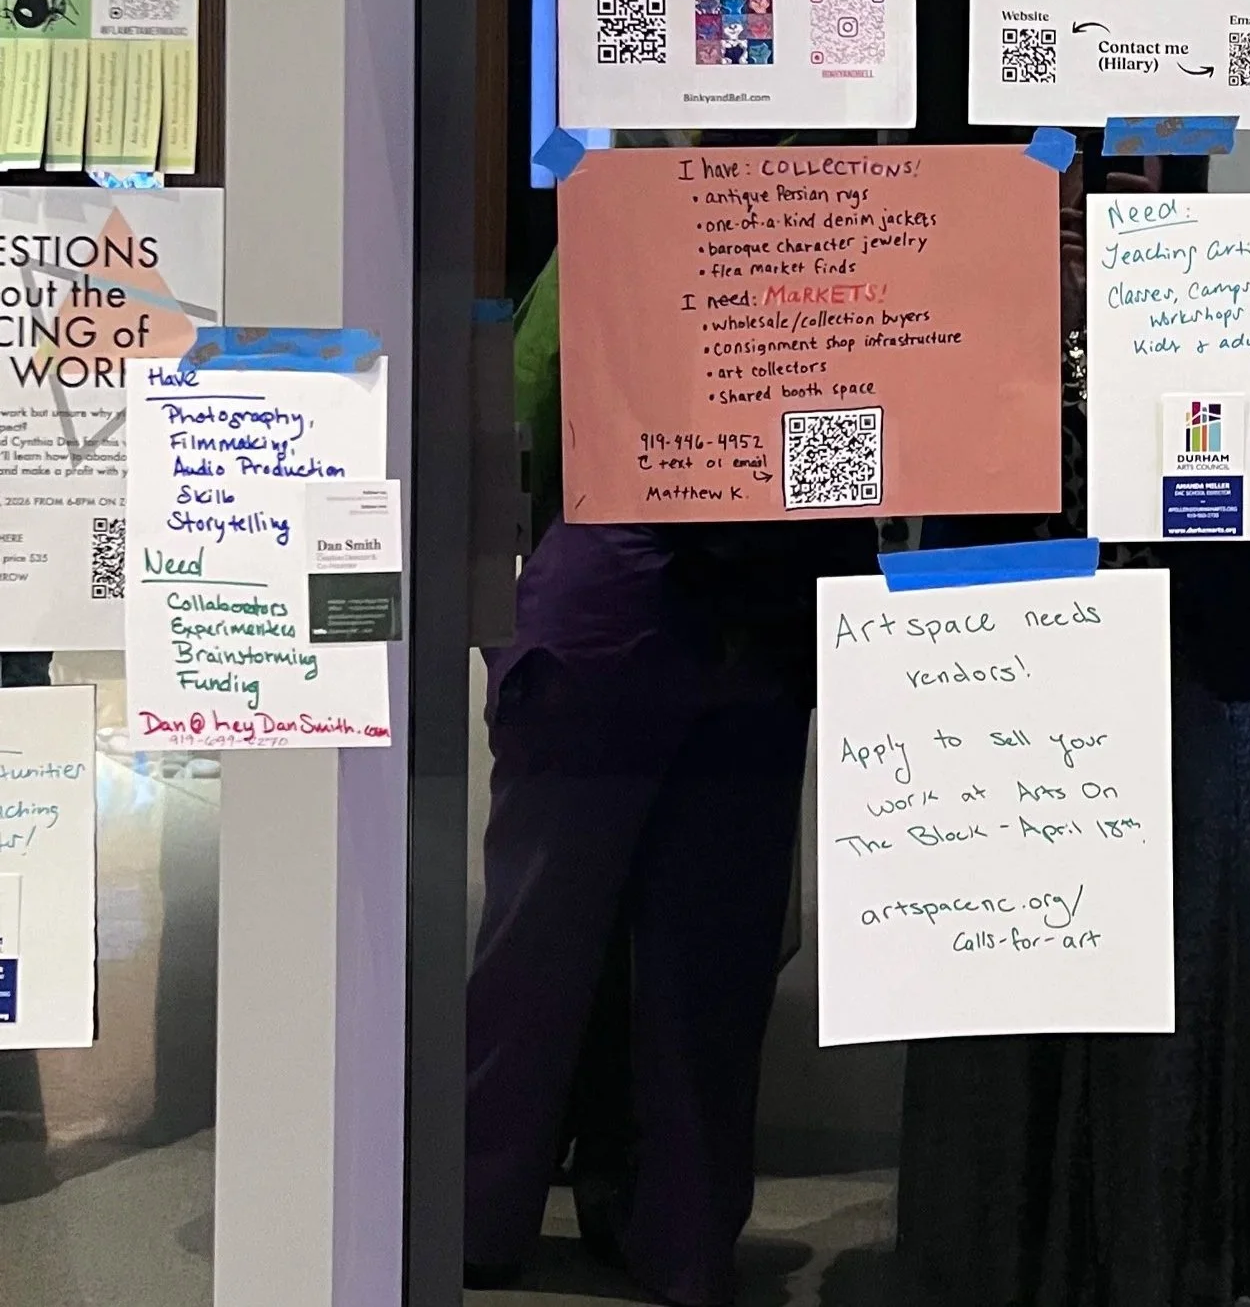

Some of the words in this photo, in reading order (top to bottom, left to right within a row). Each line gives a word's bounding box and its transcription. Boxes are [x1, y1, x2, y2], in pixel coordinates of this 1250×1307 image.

[1002, 11, 1048, 21] Website
[1099, 41, 1159, 54] Contact
[1165, 45, 1188, 54] me
[1099, 57, 1158, 73] (Hilary)
[684, 93, 770, 103] BinkyandBell.com
[678, 160, 694, 180] I
[702, 157, 750, 179] have:
[706, 189, 769, 213] antique
[777, 184, 828, 202] Persian
[837, 189, 868, 207] rugs
[72, 277, 125, 308] the
[681, 294, 696, 310] I
[708, 290, 756, 309] need:
[114, 314, 149, 348] of
[148, 366, 200, 388] Have
[641, 433, 763, 451] 919-446-4952
[646, 485, 722, 501] Matthew
[318, 540, 342, 551] Dan
[345, 539, 381, 550] Smith
[145, 546, 204, 576] Need
[1025, 602, 1101, 626] needs
[172, 640, 318, 679] Brainstorming
[907, 655, 1030, 688] vendors!
[862, 885, 1083, 933] artspacenc.org/
